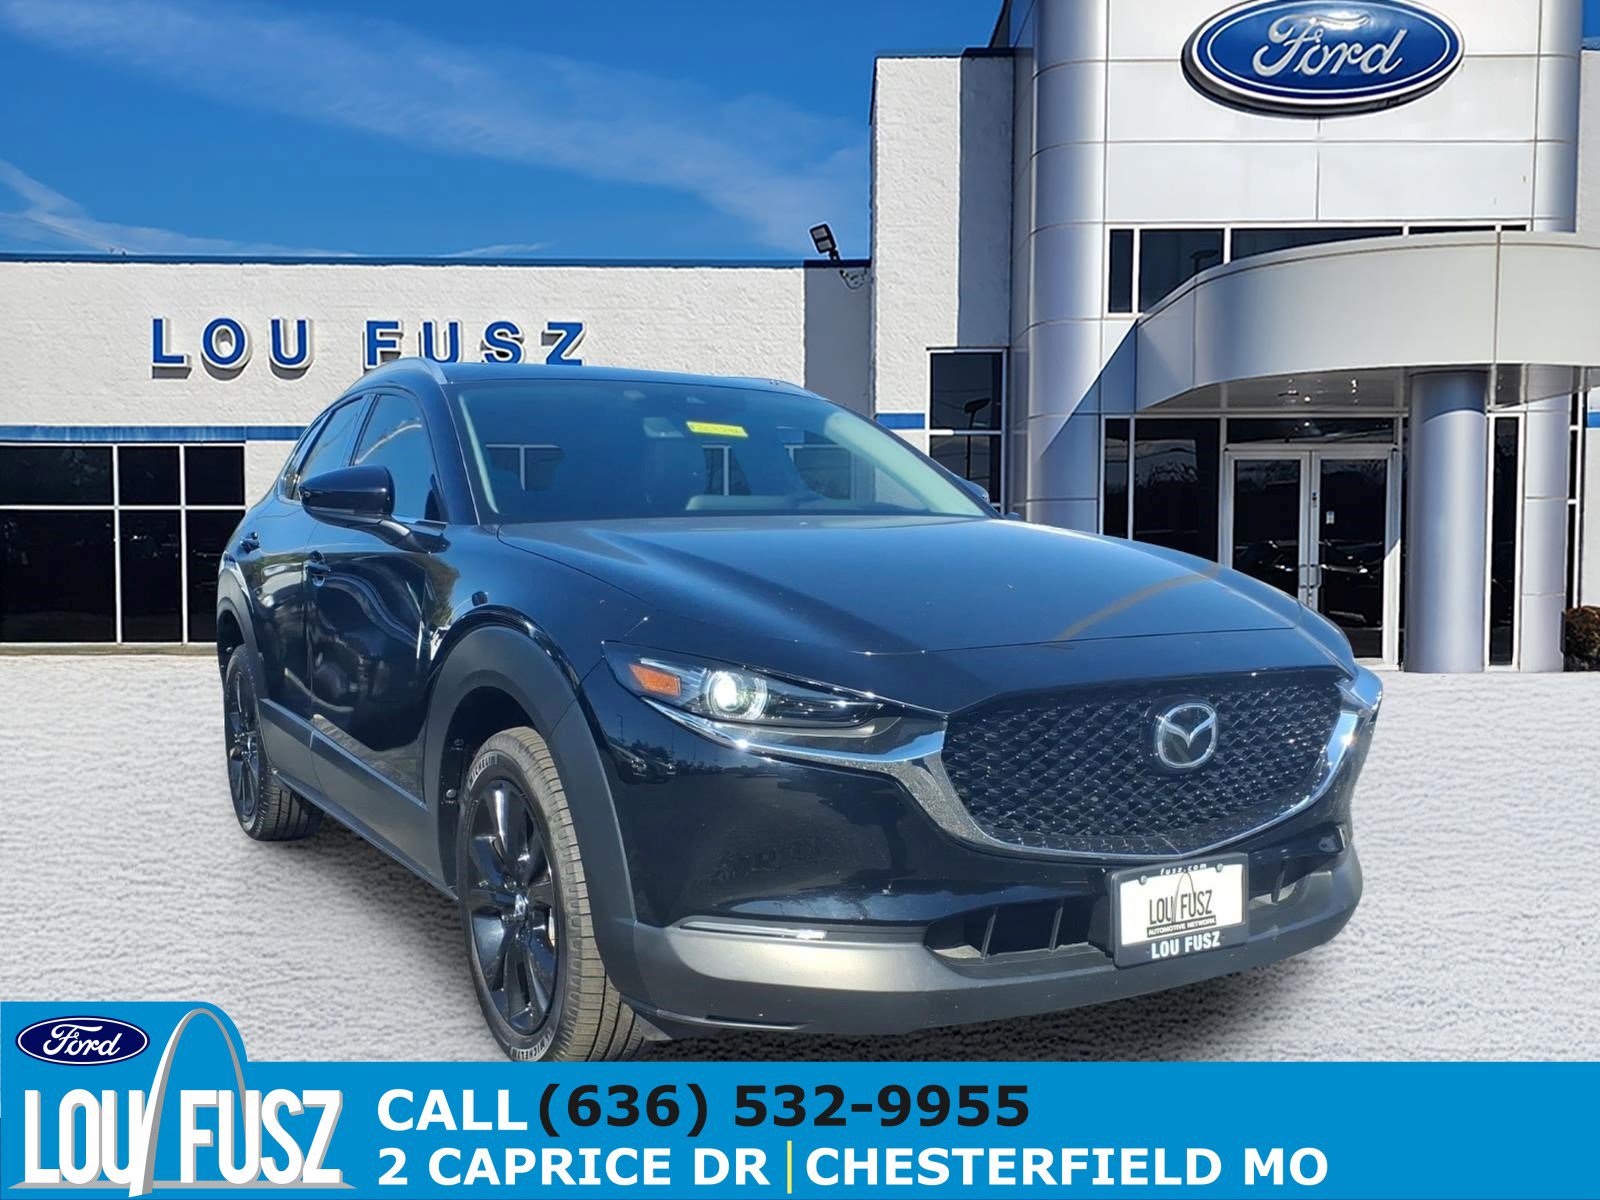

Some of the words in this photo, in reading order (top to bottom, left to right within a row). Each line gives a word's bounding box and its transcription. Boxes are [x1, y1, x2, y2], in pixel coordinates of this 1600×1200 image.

[1252, 14, 1409, 76] Ford
[152, 317, 309, 367] LOU
[365, 320, 584, 367] FUSZ
[467, 752, 498, 791] MICHELIN
[1149, 895, 1174, 925] LOU
[1180, 889, 1213, 919] FUSZ
[1151, 938, 1180, 959] LOU
[1184, 931, 1220, 953] FUSZ
